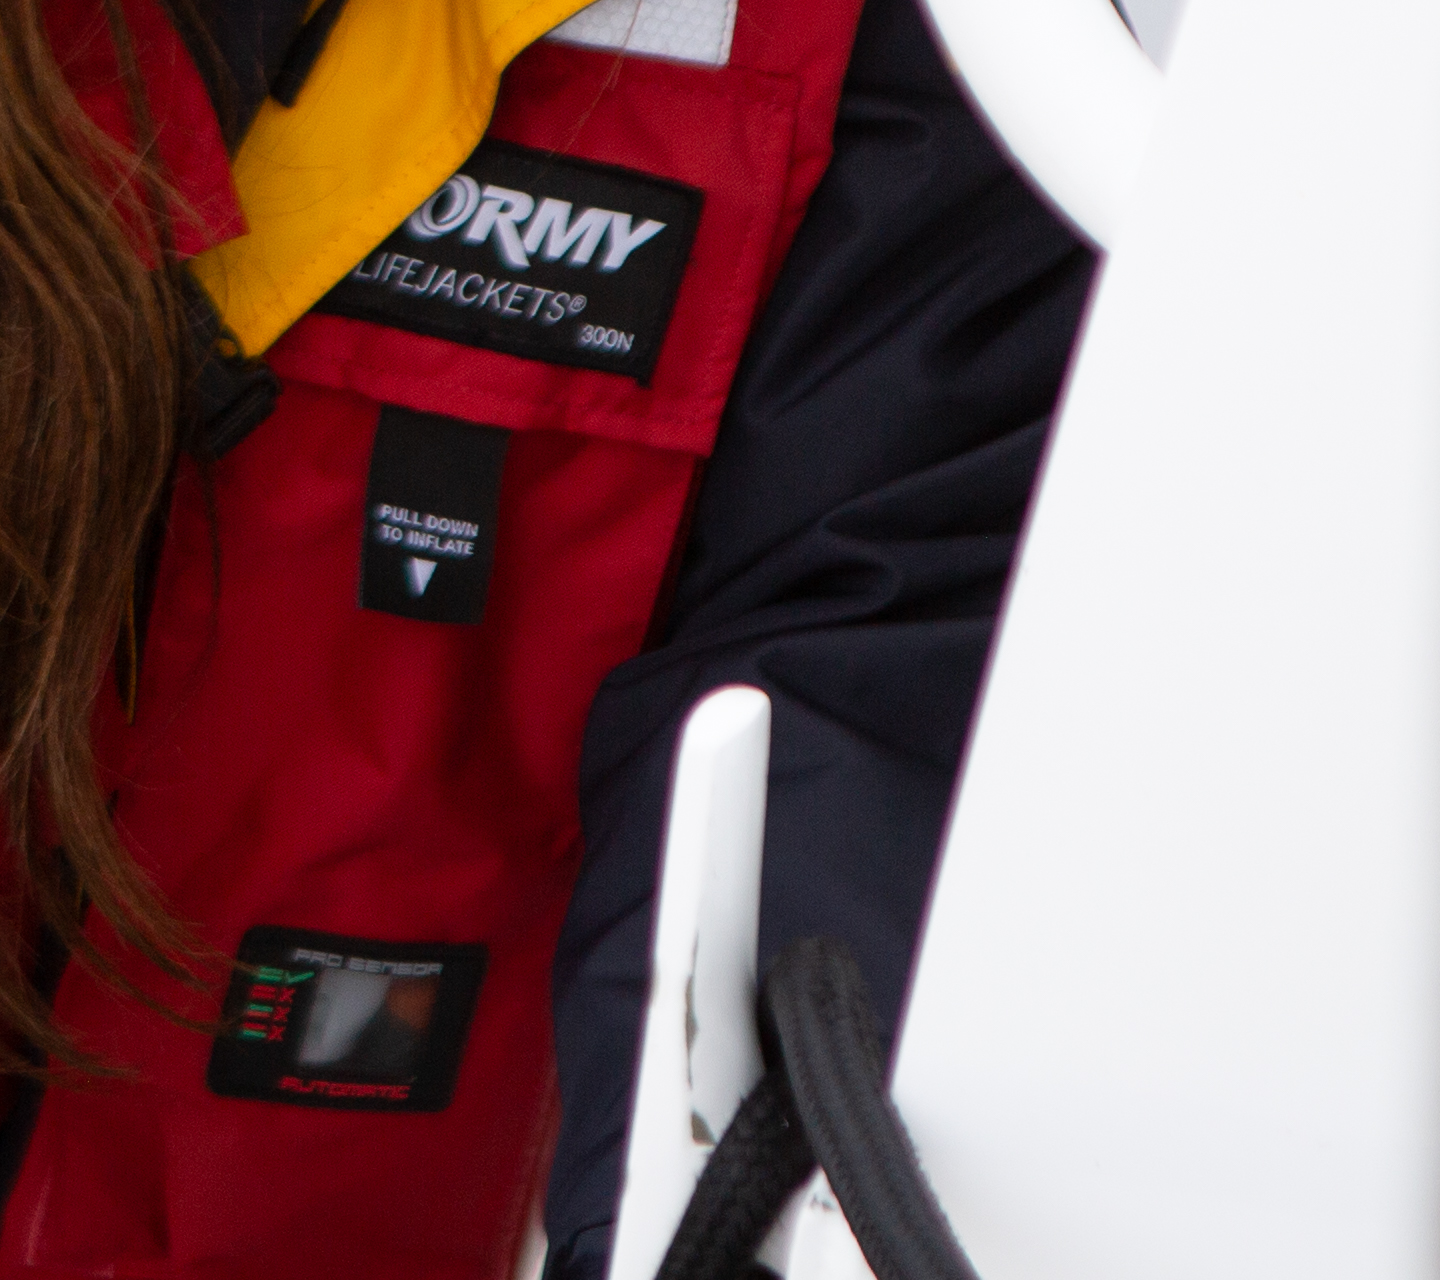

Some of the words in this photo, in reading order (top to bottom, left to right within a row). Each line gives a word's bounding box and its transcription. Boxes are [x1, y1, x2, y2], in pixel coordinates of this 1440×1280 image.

[408, 173, 668, 272] ORMY
[580, 323, 635, 353] 300N
[379, 503, 423, 526] PULL
[425, 514, 479, 538] DOWN
[381, 524, 403, 541] TO
[407, 530, 475, 556] INFLATE
